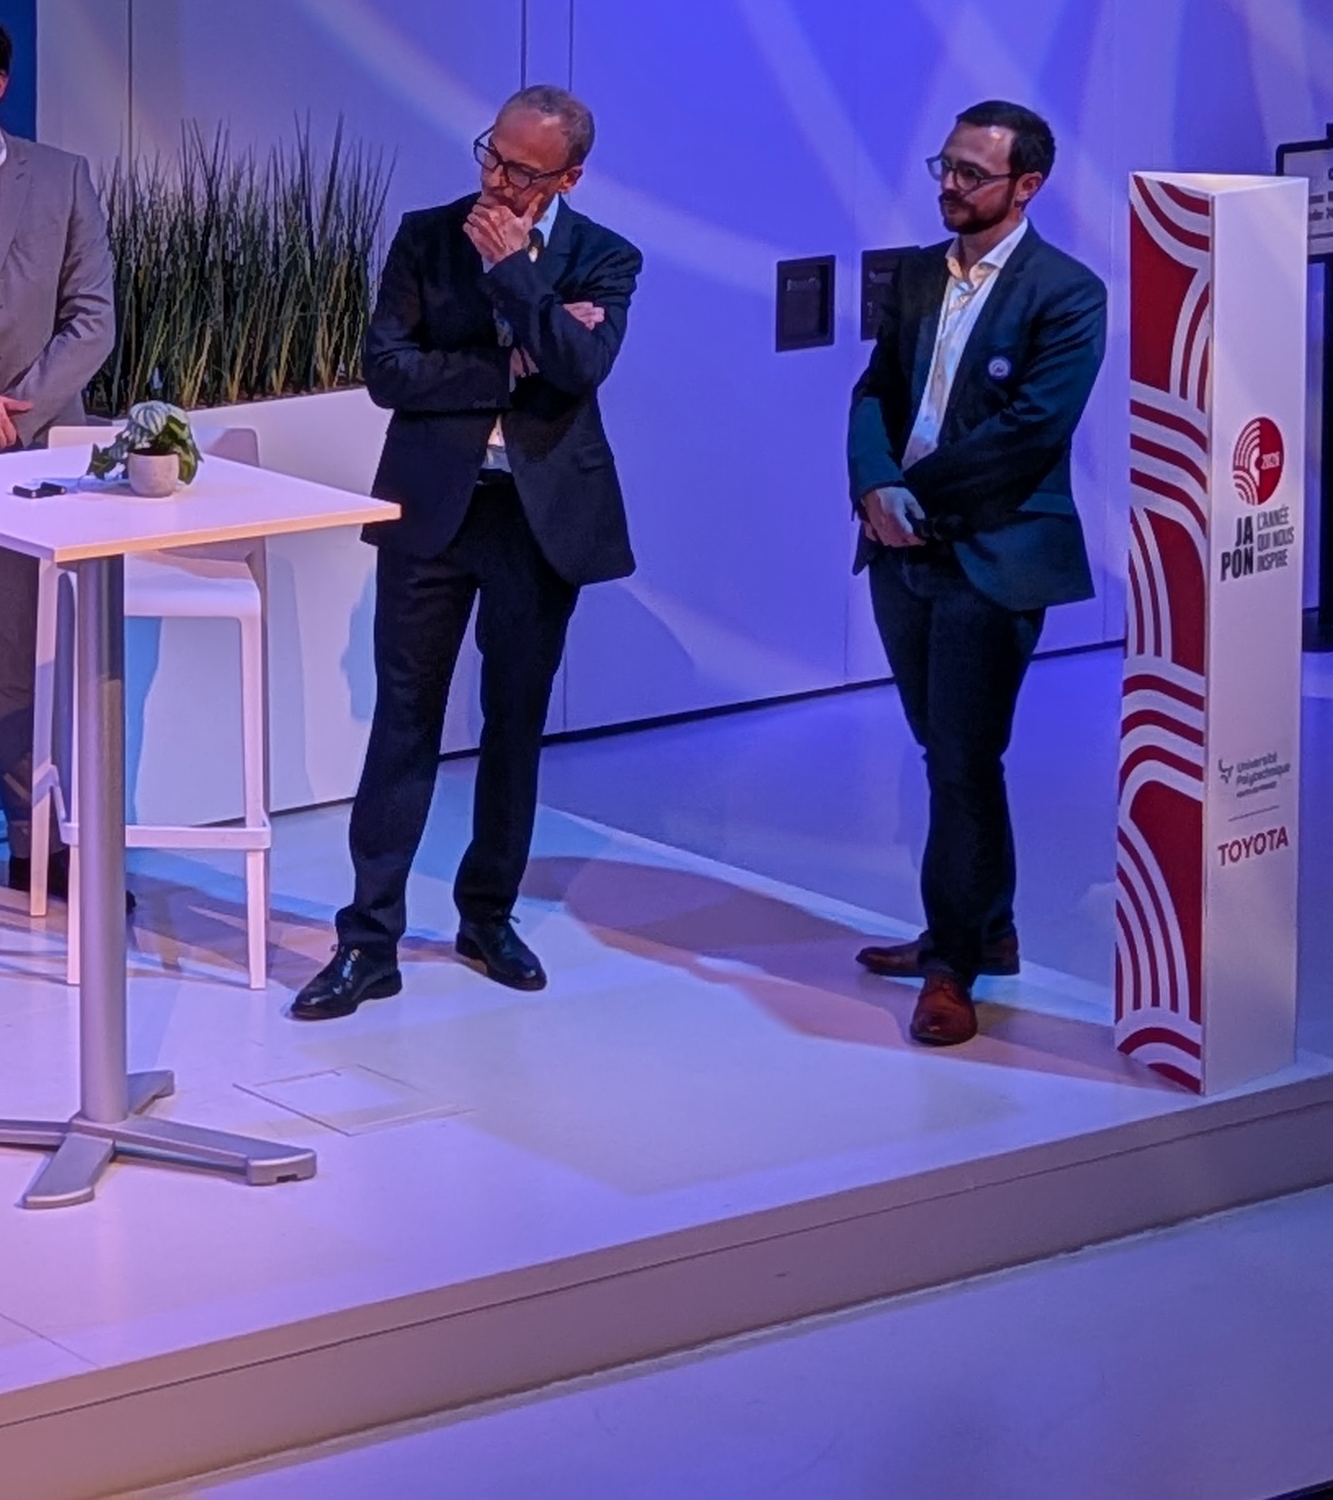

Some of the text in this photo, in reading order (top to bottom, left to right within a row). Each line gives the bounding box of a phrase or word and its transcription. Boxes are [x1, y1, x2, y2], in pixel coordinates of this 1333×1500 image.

[1235, 516, 1254, 547] JA
[1221, 546, 1254, 582] PON
[1217, 826, 1290, 867] TOYOTA
